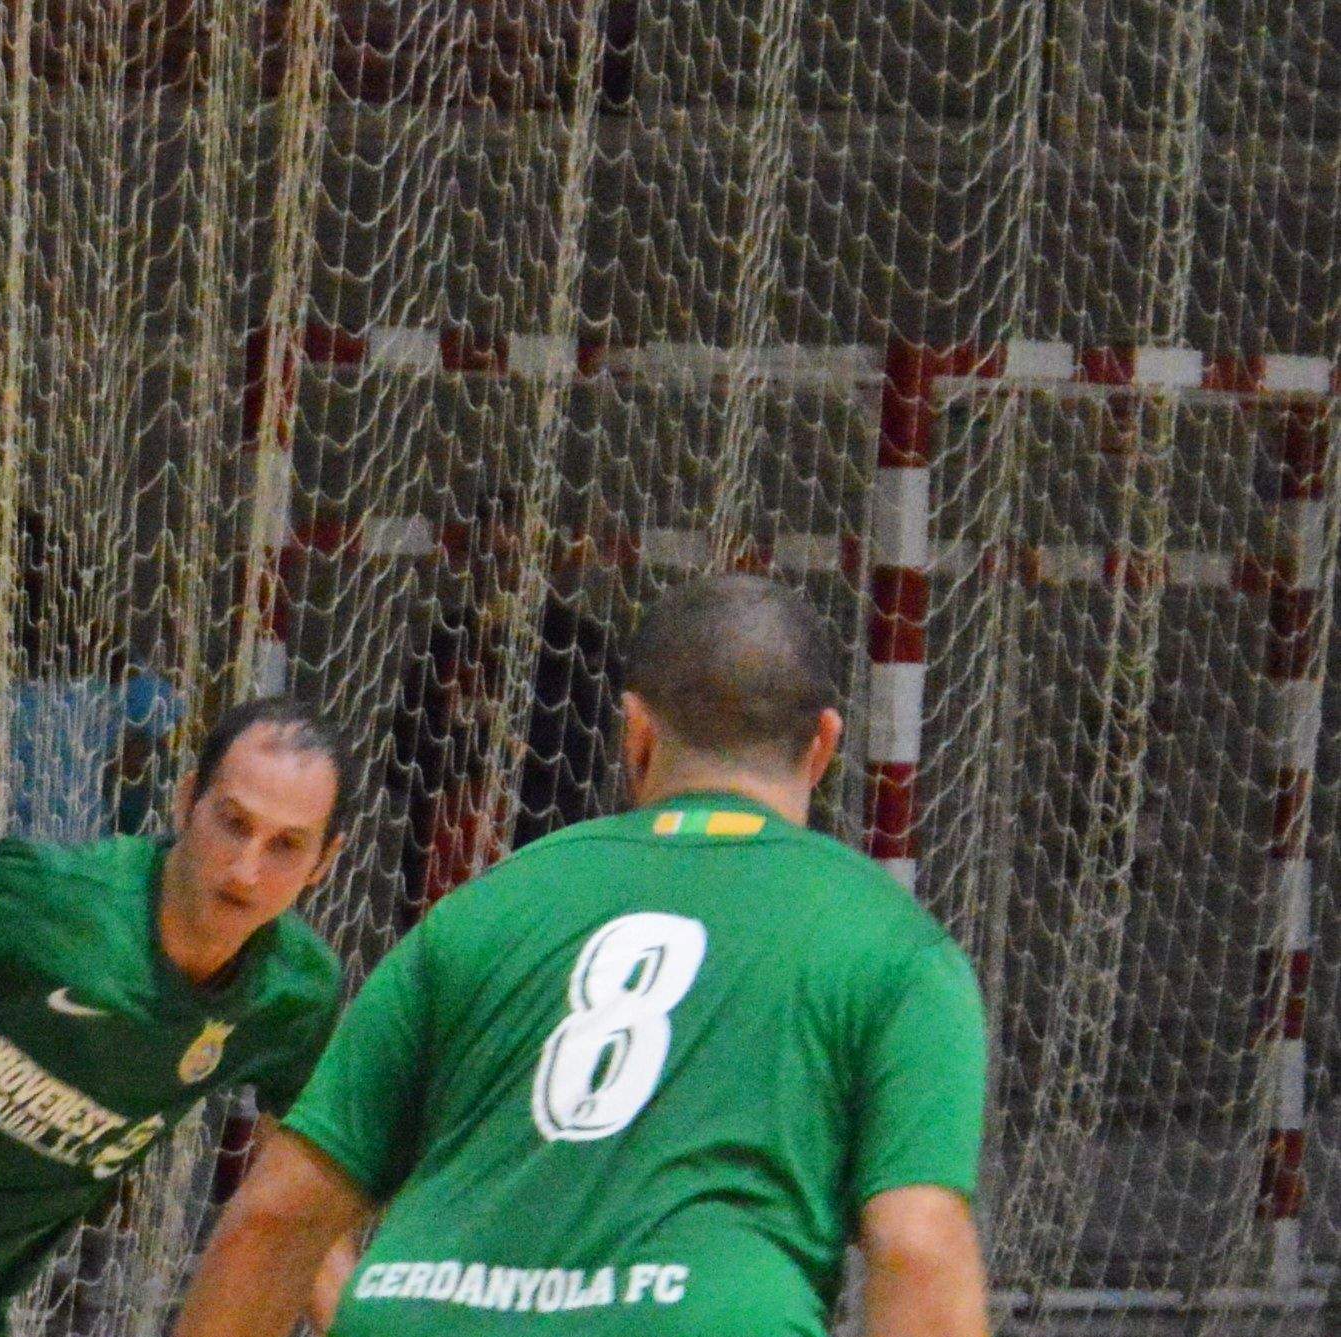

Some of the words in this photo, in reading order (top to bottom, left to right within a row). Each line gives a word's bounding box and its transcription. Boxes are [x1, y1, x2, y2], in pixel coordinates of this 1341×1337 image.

[532, 912, 707, 1141] 8
[356, 1260, 615, 1312] CERDANYOLA
[625, 1264, 689, 1304] FC
